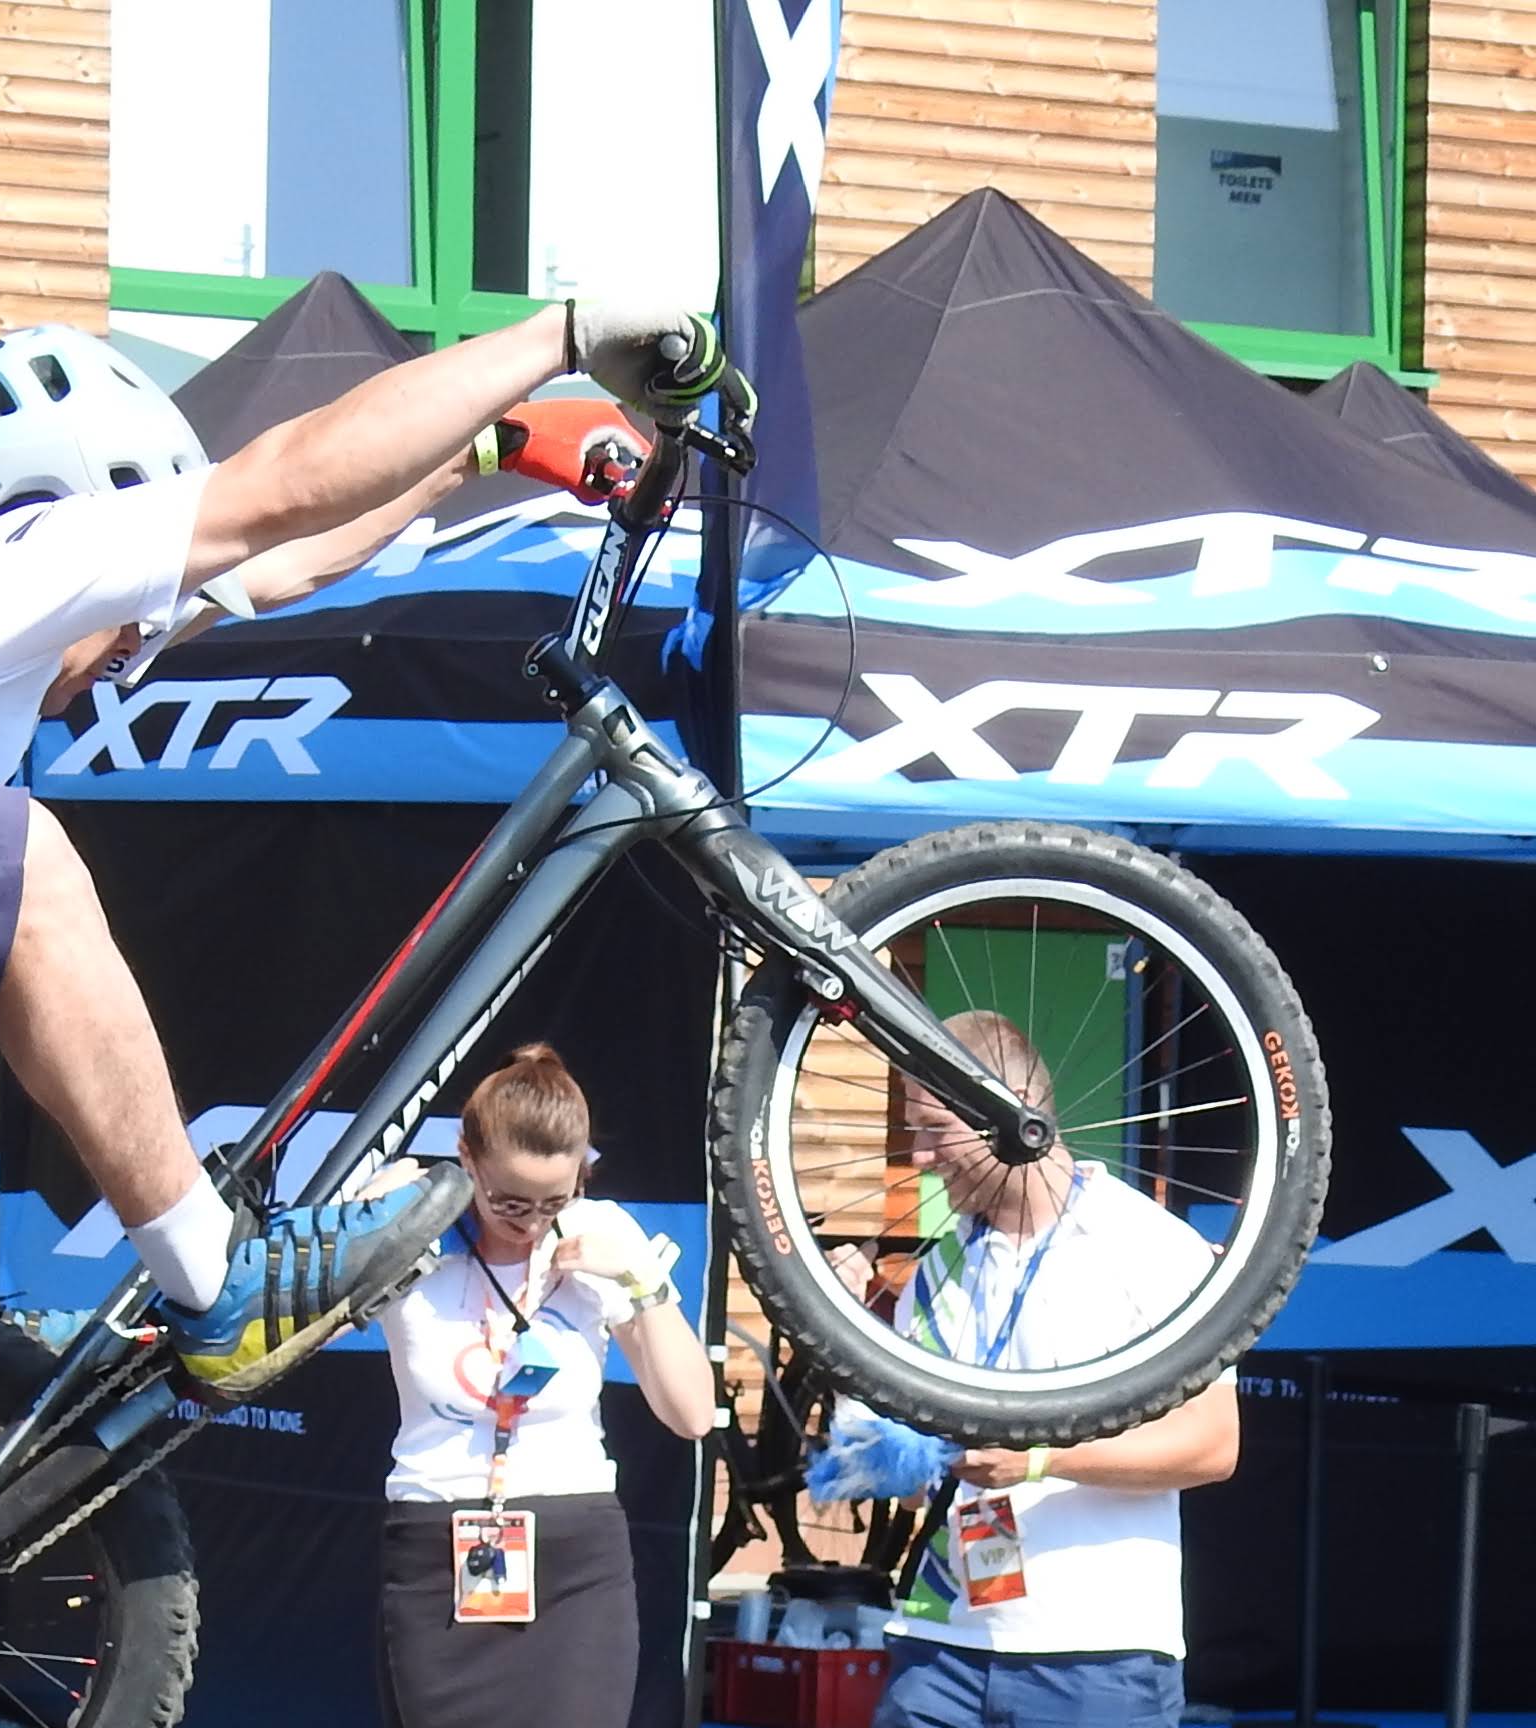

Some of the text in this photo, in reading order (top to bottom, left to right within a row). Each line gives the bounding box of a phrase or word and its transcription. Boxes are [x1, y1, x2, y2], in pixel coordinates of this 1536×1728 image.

[582, 520, 627, 656] CLEAN
[44, 675, 353, 775] XTR
[786, 673, 1382, 801] XTR
